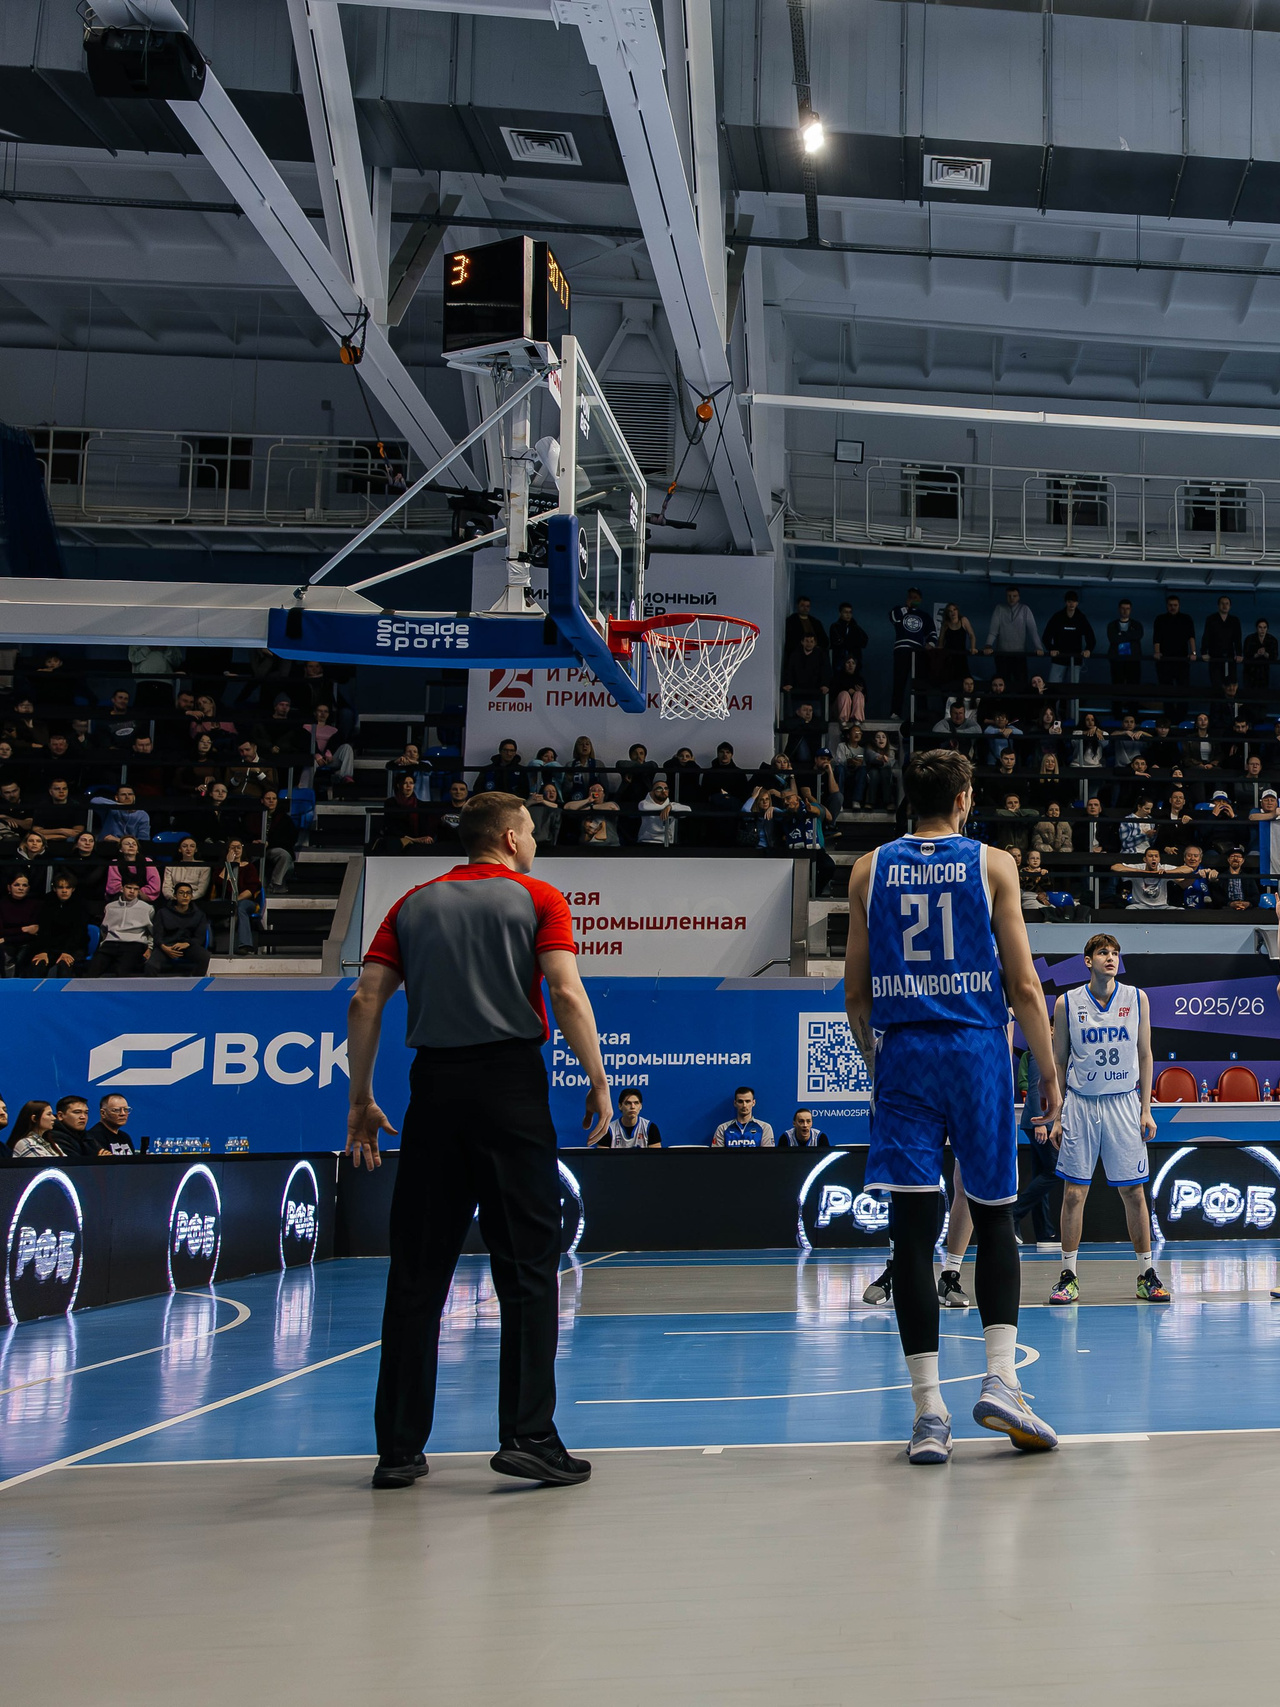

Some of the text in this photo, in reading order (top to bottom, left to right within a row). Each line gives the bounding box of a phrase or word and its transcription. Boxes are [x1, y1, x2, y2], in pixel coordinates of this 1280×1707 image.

[377, 619, 470, 635] Schelde
[376, 633, 469, 651] Sports
[488, 701, 533, 712] РЕГИОН
[886, 862, 967, 887] ДЕНИСОВ
[900, 892, 954, 962] 21
[872, 970, 993, 999] ВЛАДИВОСТОК
[1174, 995, 1266, 1017] 2025/26
[553, 1029, 631, 1049] Ркая
[1081, 1025, 1131, 1045] ЮГРА
[212, 1031, 351, 1089] ВСК
[553, 1050, 751, 1069] Рыпромышленная
[1094, 1047, 1120, 1067] 38
[552, 1071, 649, 1087] Комания
[1104, 1069, 1129, 1081] Utair
[815, 1185, 889, 1234] РФ
[1168, 1182, 1277, 1230] РФБ
[14, 1225, 75, 1283] РФБ
